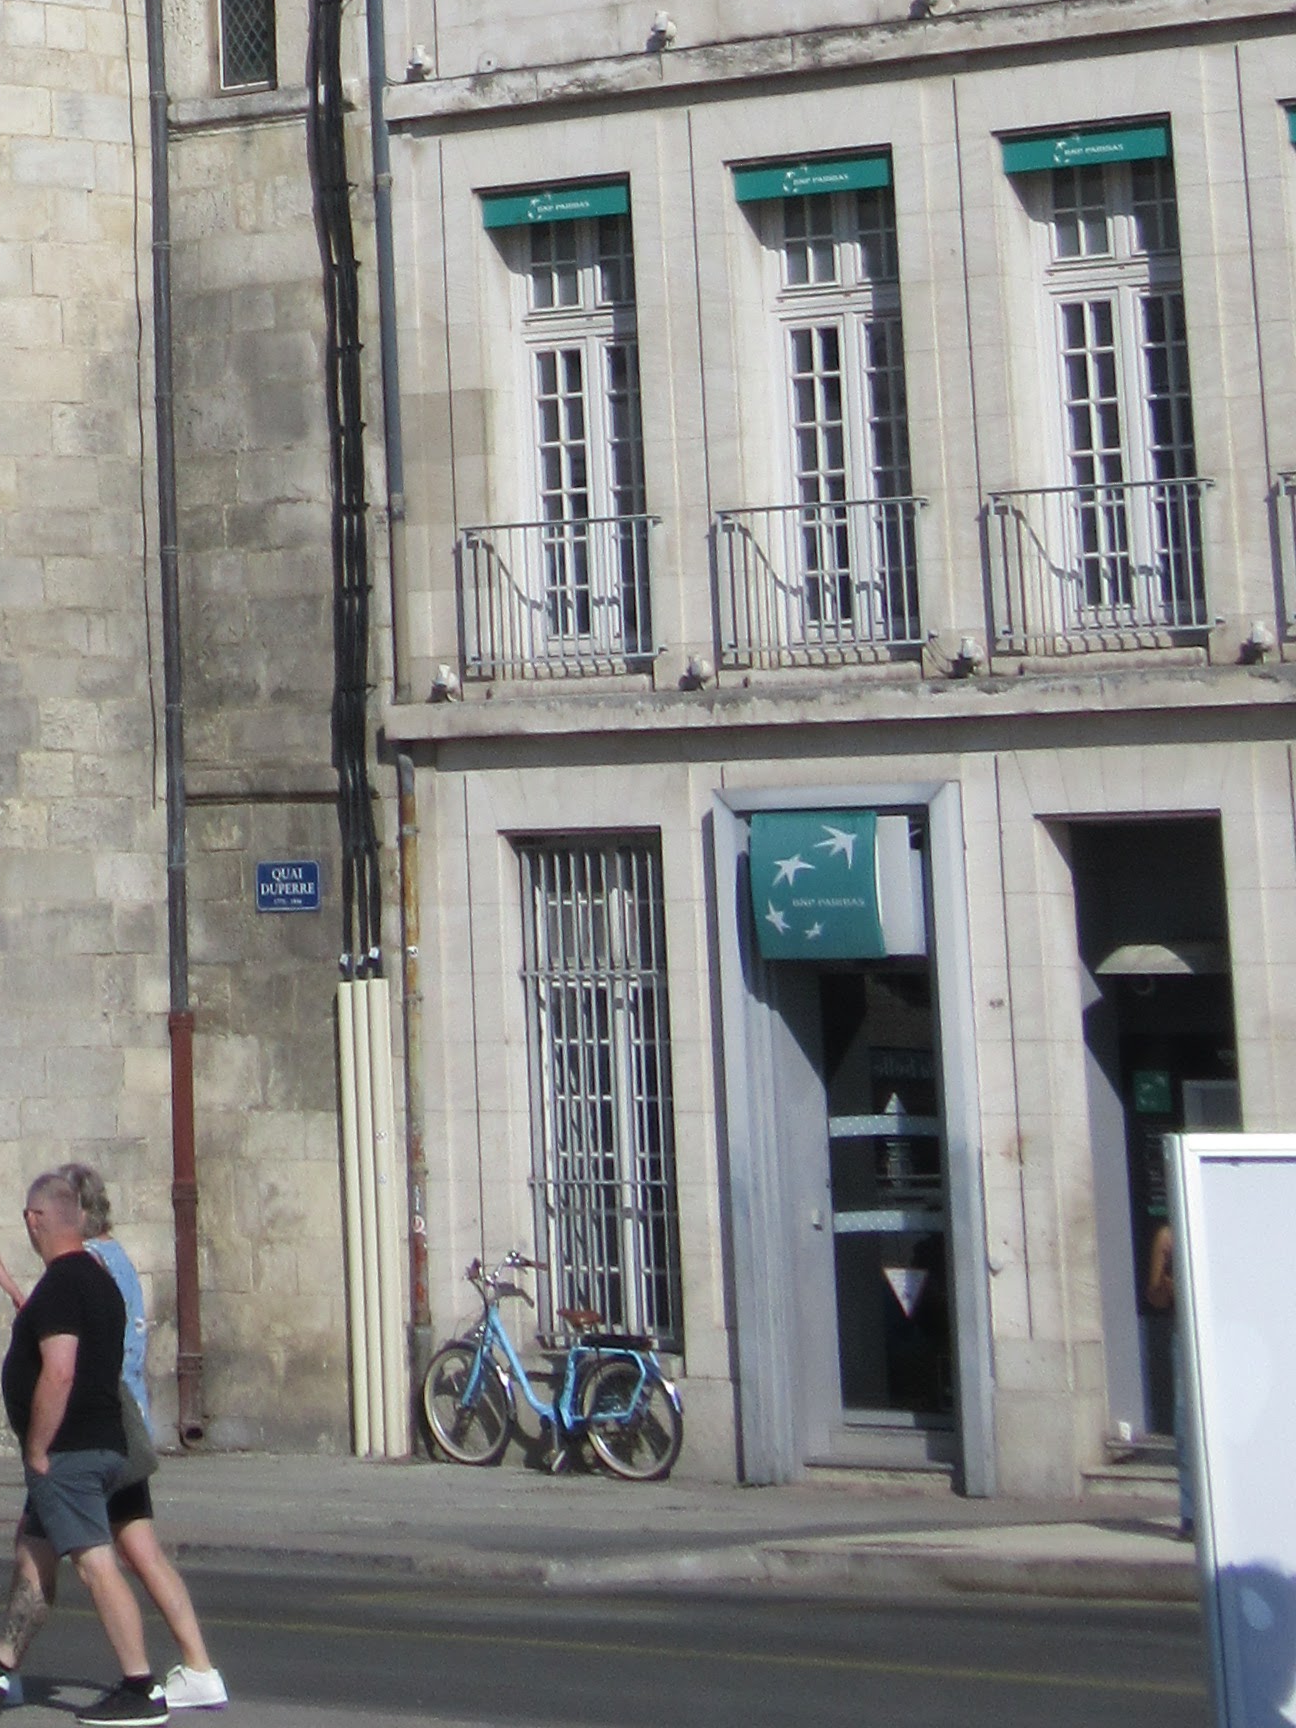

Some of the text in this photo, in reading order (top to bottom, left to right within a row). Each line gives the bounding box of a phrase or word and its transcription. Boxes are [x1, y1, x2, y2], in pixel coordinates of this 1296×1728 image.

[271, 867, 303, 882] QUAI
[260, 882, 316, 895] DUPERRE
[792, 897, 866, 908] BNP PARIBAS
